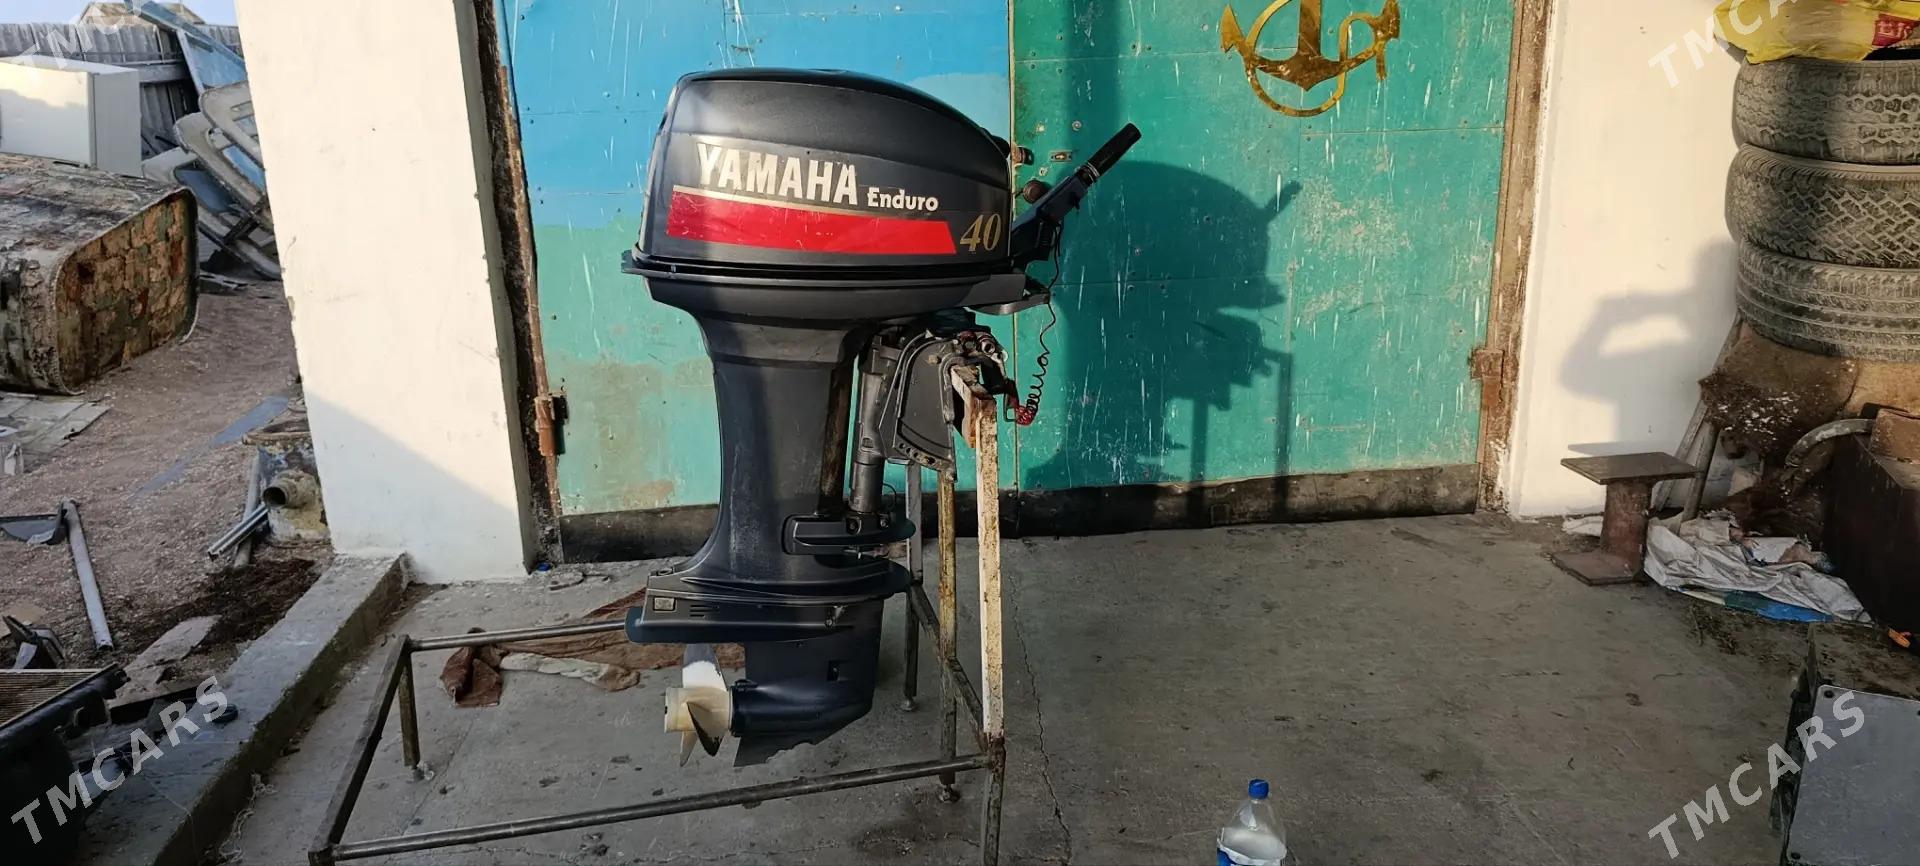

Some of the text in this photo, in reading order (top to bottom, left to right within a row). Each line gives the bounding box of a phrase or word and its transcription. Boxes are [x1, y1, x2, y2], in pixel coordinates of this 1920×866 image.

[697, 143, 939, 212] YAMAHA Enduro
[960, 213, 1001, 251] 40
